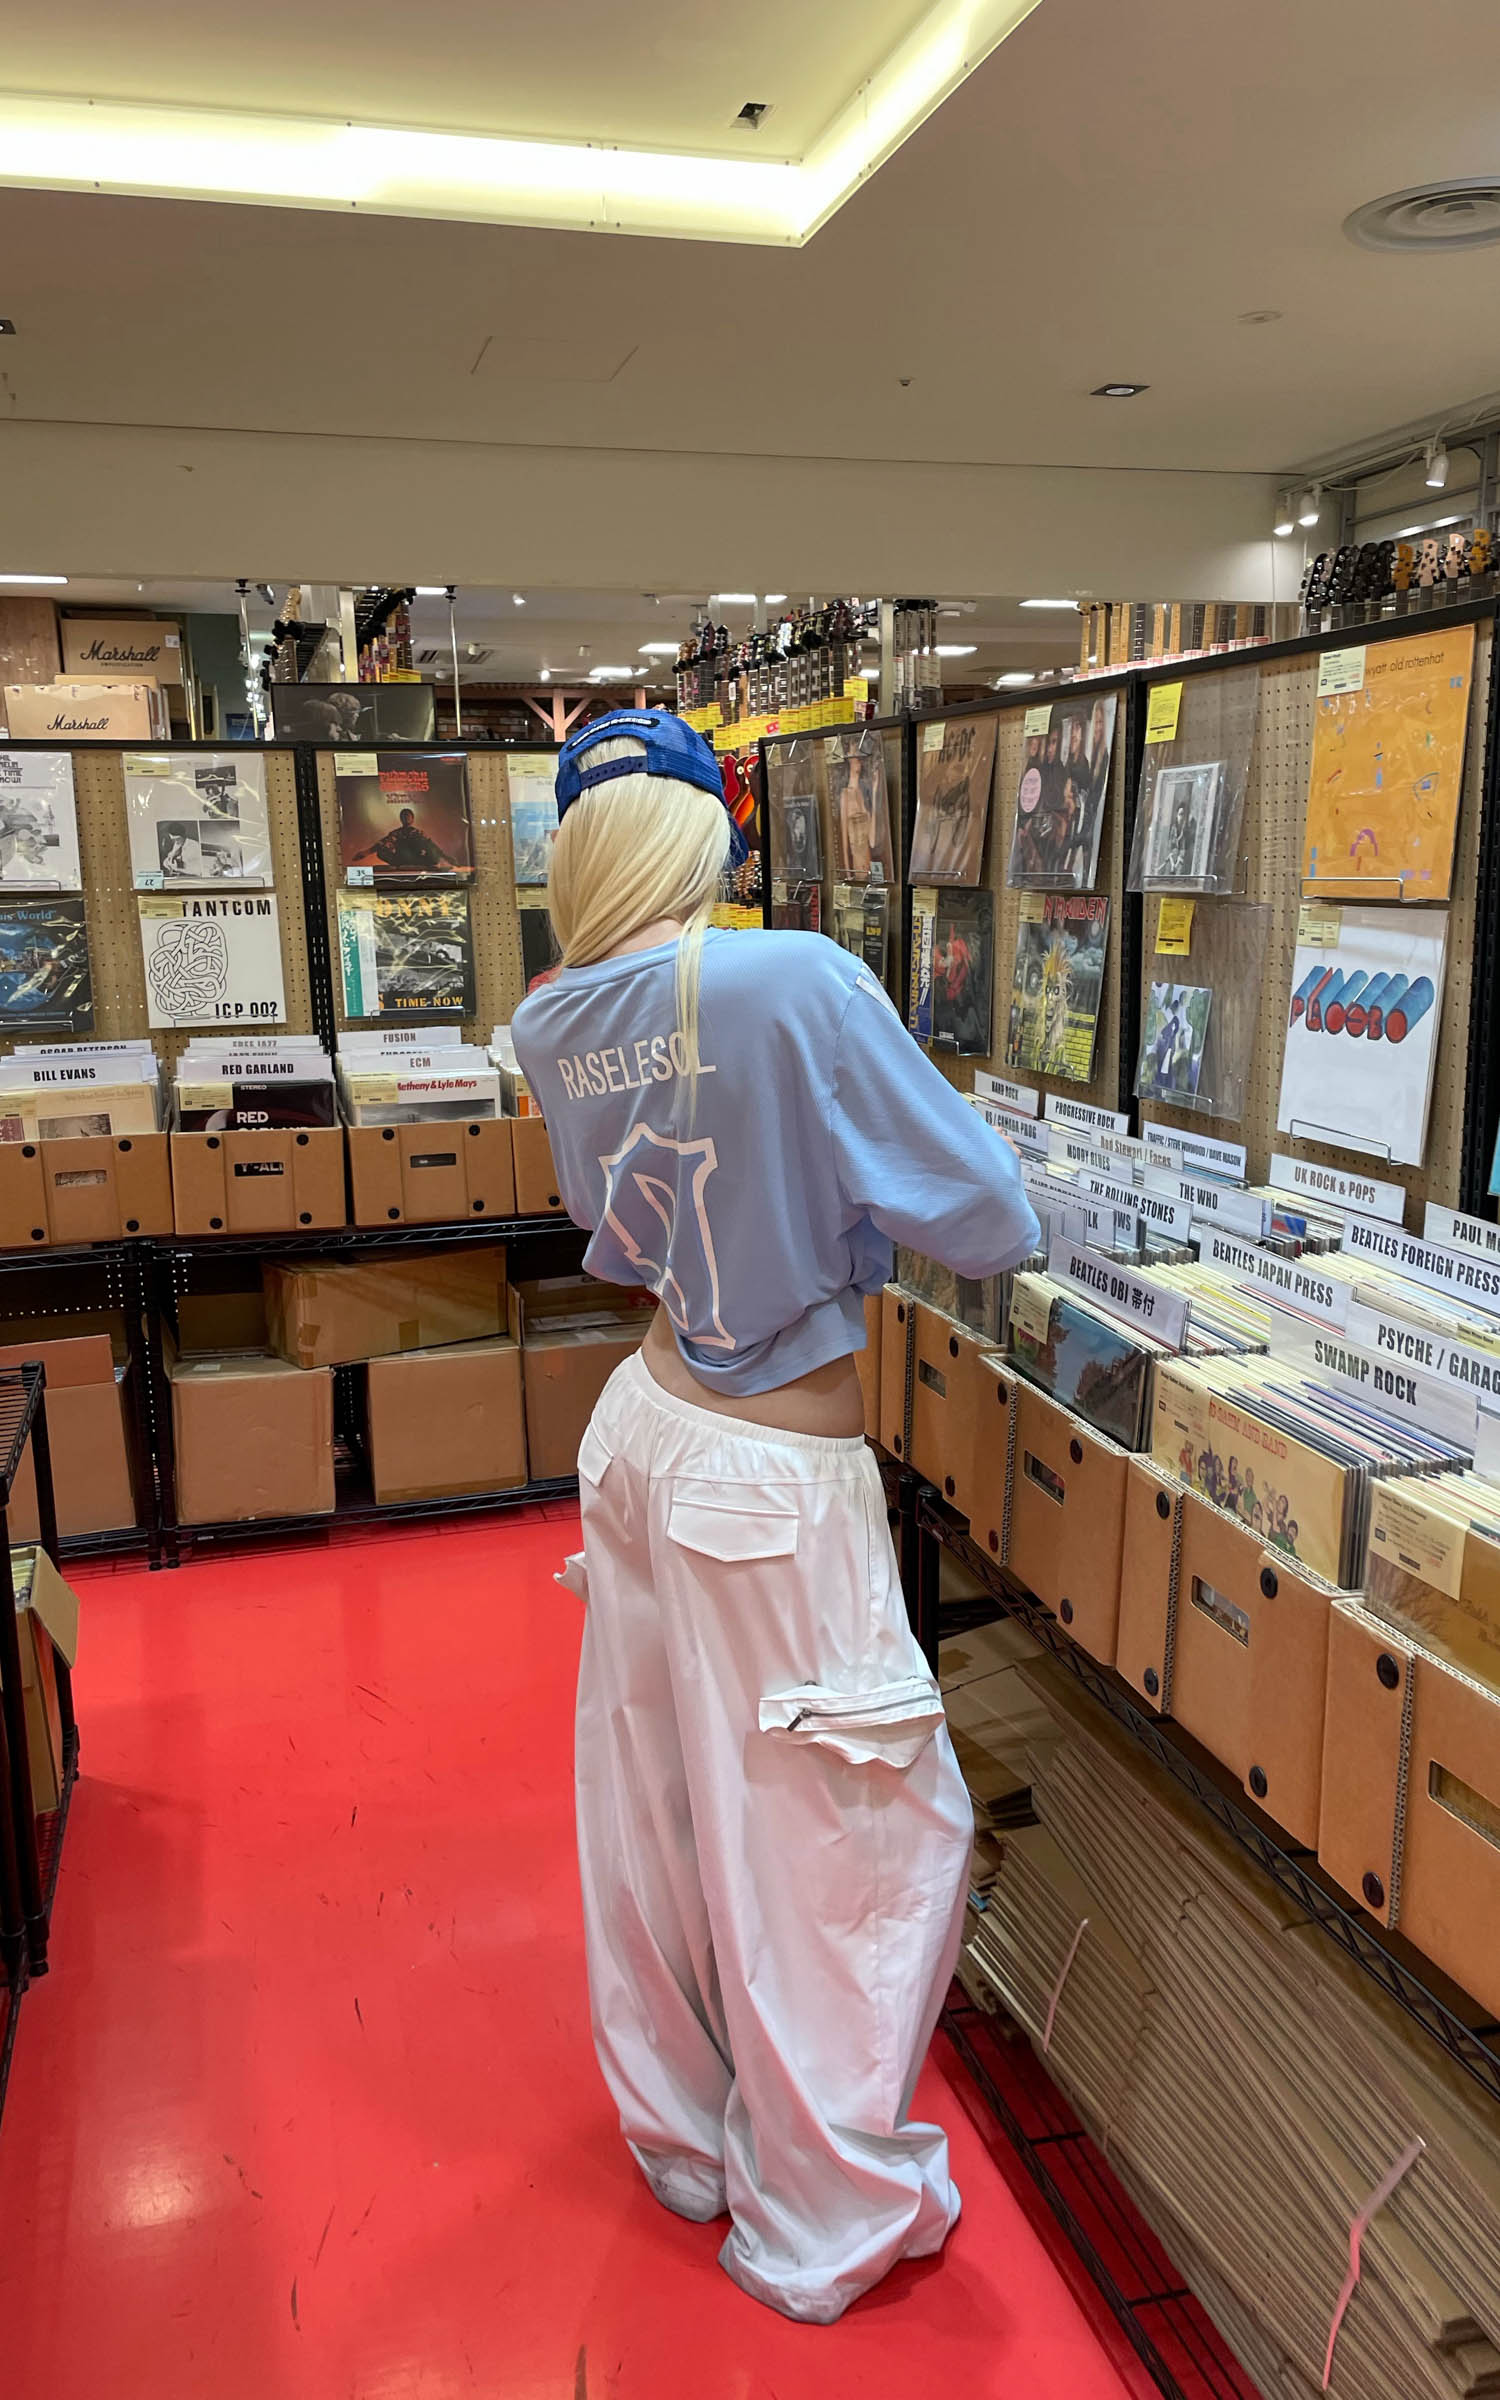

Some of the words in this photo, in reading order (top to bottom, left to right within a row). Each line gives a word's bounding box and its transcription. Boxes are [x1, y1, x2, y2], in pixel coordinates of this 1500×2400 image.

[80, 640, 160, 661] Marshall
[47, 714, 109, 730] Marshall
[1055, 896, 1109, 921] MAIDEN
[215, 1003, 244, 1018] ICP
[250, 1001, 279, 1018] 002
[395, 997, 428, 1008] TIME
[433, 996, 464, 1006] NOW
[383, 1032, 417, 1043] FUSION
[222, 1064, 242, 1075] RED
[245, 1063, 294, 1075] GARLAND
[410, 1057, 431, 1068] ECM
[33, 1070, 57, 1082] BILL
[60, 1068, 96, 1081] EVANS
[455, 1078, 477, 1089] Mays
[1005, 1084, 1019, 1100] ROCK
[236, 1111, 269, 1124] RED
[1055, 1101, 1096, 1125] PROGRESSIVE
[1097, 1113, 1115, 1130] ROCK
[1020, 1122, 1037, 1139] PROG
[1066, 1143, 1089, 1165] MOODY
[1100, 1135, 1113, 1152] Rod
[1147, 1131, 1165, 1146] TRAFFIC
[1167, 1137, 1181, 1151] STEVE
[1209, 1148, 1222, 1162] DAVE
[1294, 1165, 1307, 1187] UK
[1309, 1169, 1336, 1193] ROCK
[1338, 1181, 1346, 1195] &
[1349, 1180, 1376, 1204] POPS
[1090, 1180, 1104, 1198] THE
[1105, 1184, 1139, 1210] ROLLING
[1139, 1198, 1175, 1226] STONES
[1180, 1182, 1195, 1202] THE
[1196, 1188, 1218, 1210] WHO
[1452, 1219, 1482, 1247] PAUL
[1351, 1224, 1398, 1258] BEATLES
[1401, 1242, 1454, 1279] FOREIGN
[1456, 1262, 1500, 1296] PRESS
[1212, 1238, 1255, 1273] BEATLES
[1257, 1255, 1292, 1290] JAPAN
[1294, 1270, 1333, 1307] PRESS
[1069, 1256, 1108, 1293] BEATLES
[1110, 1277, 1129, 1304] OBI
[1131, 1287, 1155, 1317] 帯付
[1377, 1323, 1433, 1367] PSYCHE
[1436, 1348, 1446, 1370] /
[1449, 1352, 1500, 1395] GARAG
[1314, 1339, 1370, 1383] SWAMP
[1374, 1364, 1417, 1406] ROCK
